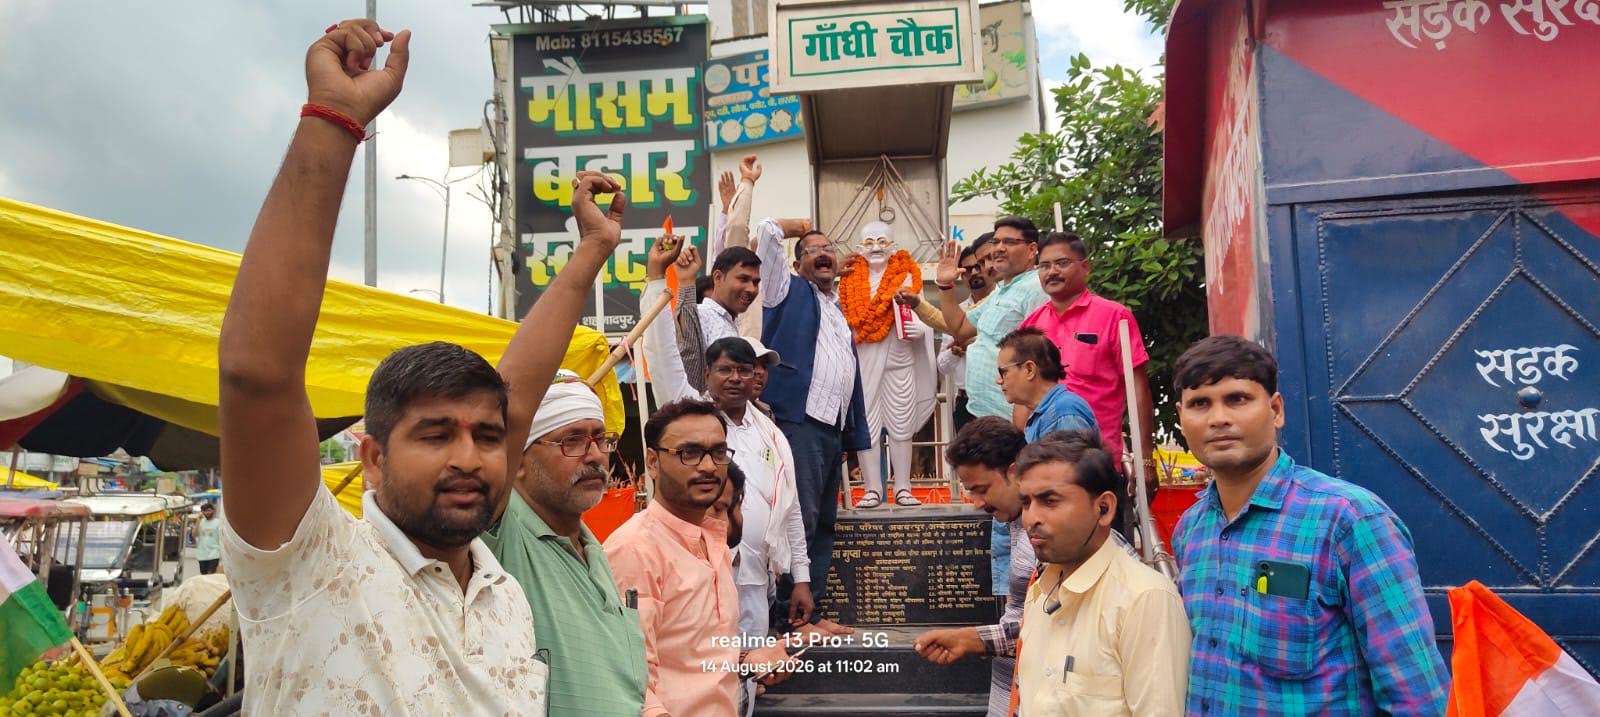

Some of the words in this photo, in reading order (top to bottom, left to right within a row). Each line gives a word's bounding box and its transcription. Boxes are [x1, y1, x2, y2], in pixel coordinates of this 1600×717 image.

[535, 34, 576, 52] Mab:
[580, 26, 684, 49] 8115435567
[887, 18, 954, 57] चौक
[1383, 0, 1491, 50] सड़क
[520, 56, 699, 134] मौसम
[524, 140, 698, 207] बहार
[1477, 408, 1600, 460] सुरक्षा
